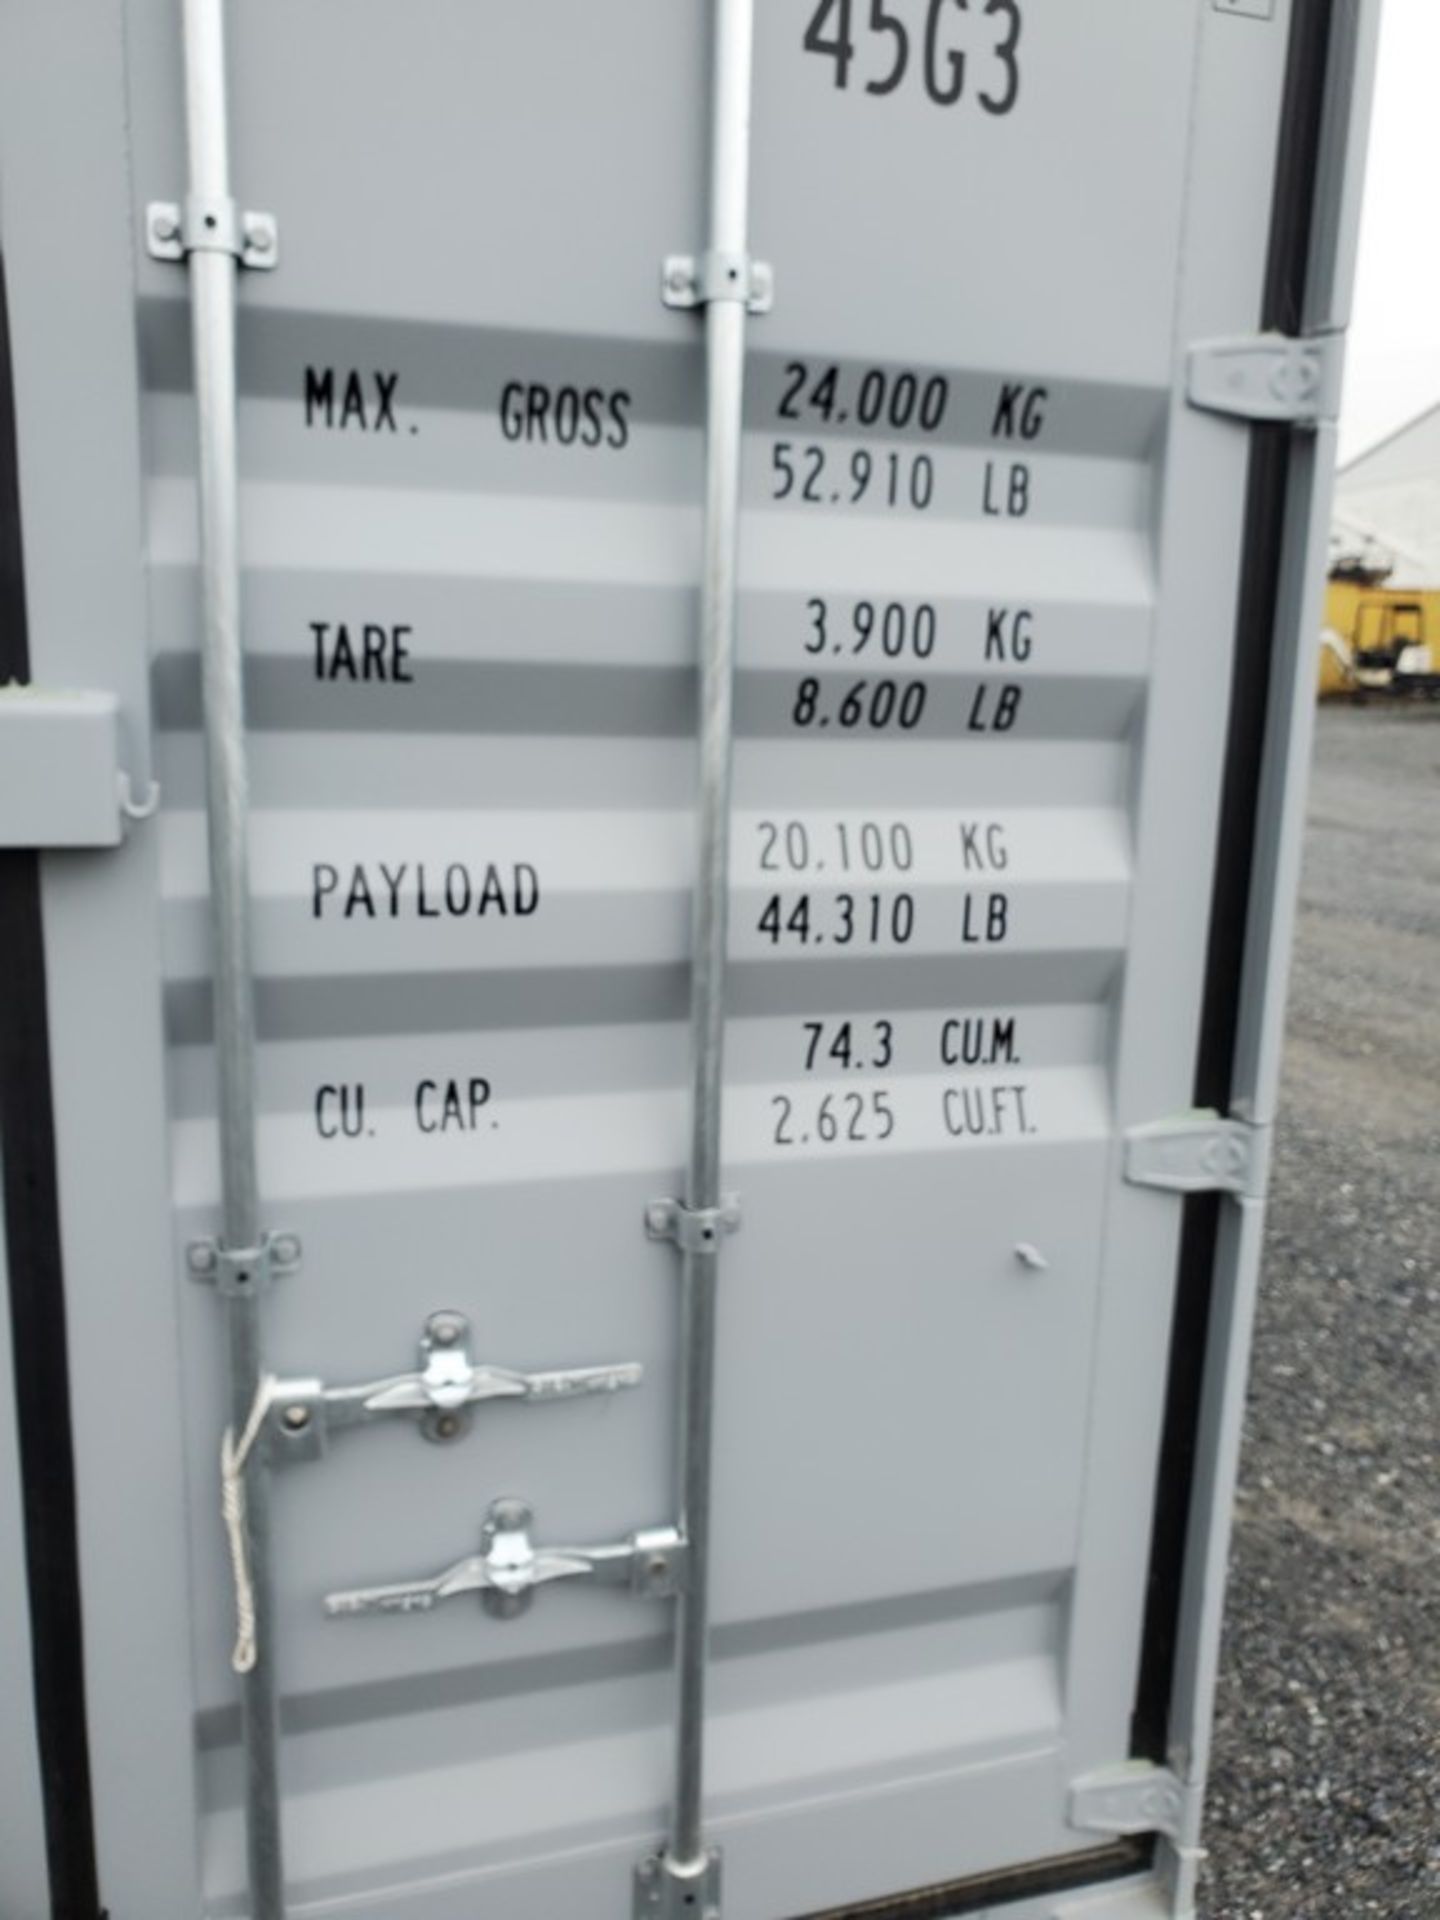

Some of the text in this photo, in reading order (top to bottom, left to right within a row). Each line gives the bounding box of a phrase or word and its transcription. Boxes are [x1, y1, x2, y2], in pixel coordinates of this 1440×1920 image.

[803, 0, 1021, 115] 45G3
[304, 364, 631, 449] MAX. GROSS
[777, 361, 1048, 440] 24.000 KG
[772, 442, 1029, 518] 52.910 LB
[308, 620, 414, 684] TARE
[804, 597, 1033, 662] 3.900 KG
[791, 676, 1022, 732] 8.600 LB
[756, 820, 1009, 872] 20.100 KG
[312, 862, 540, 919] PAYLOAD
[756, 892, 1008, 945] 44.310 LB
[803, 1019, 894, 1071] 74.3
[314, 1076, 499, 1139] CU. CAP.
[771, 1090, 894, 1145] 2.625
